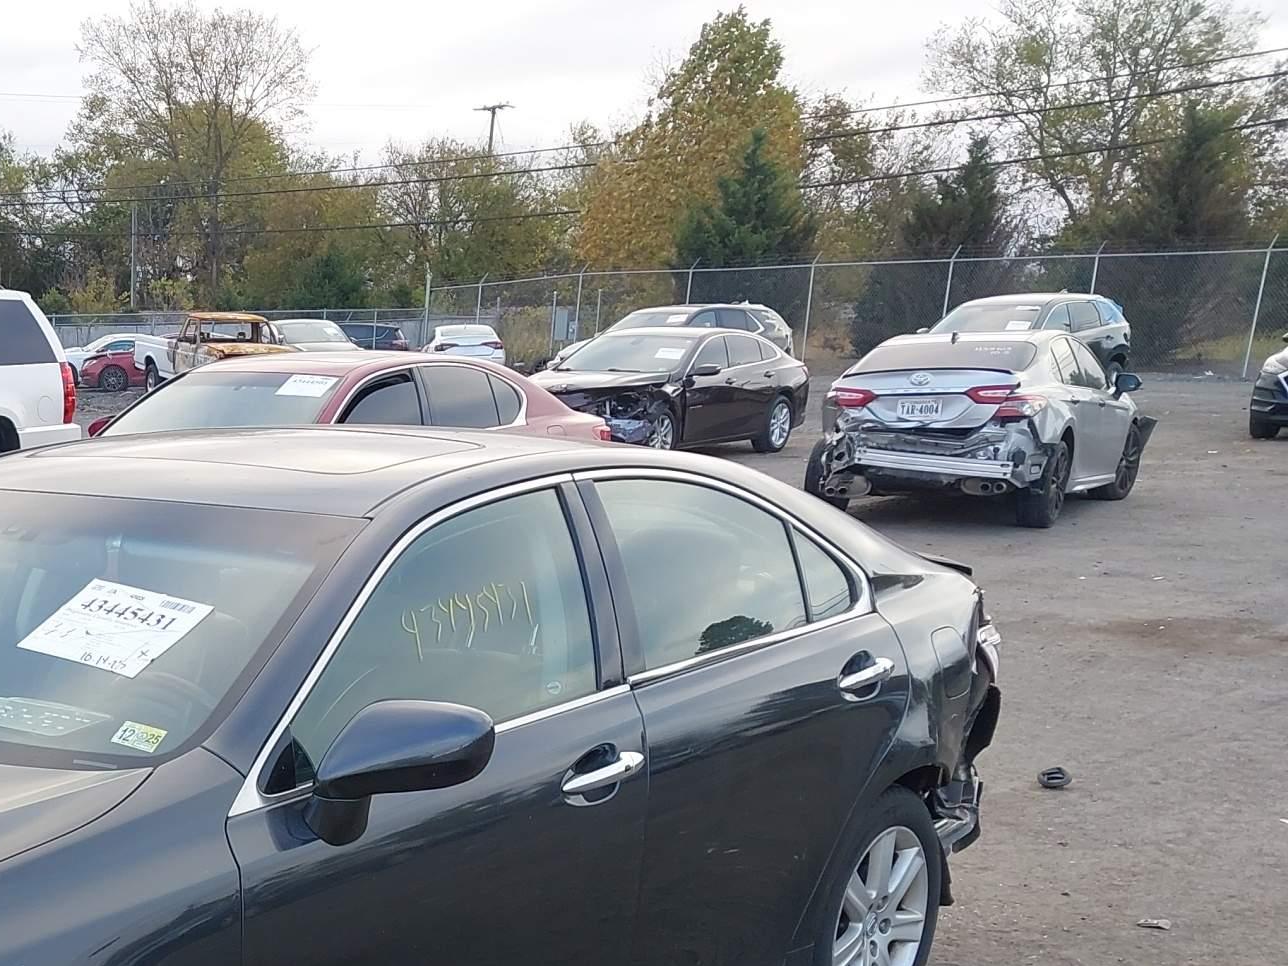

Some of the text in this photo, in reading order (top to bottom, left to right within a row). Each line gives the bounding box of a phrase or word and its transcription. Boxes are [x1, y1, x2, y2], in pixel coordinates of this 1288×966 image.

[80, 597, 177, 631] 43445431
[117, 727, 162, 745] 12 25
